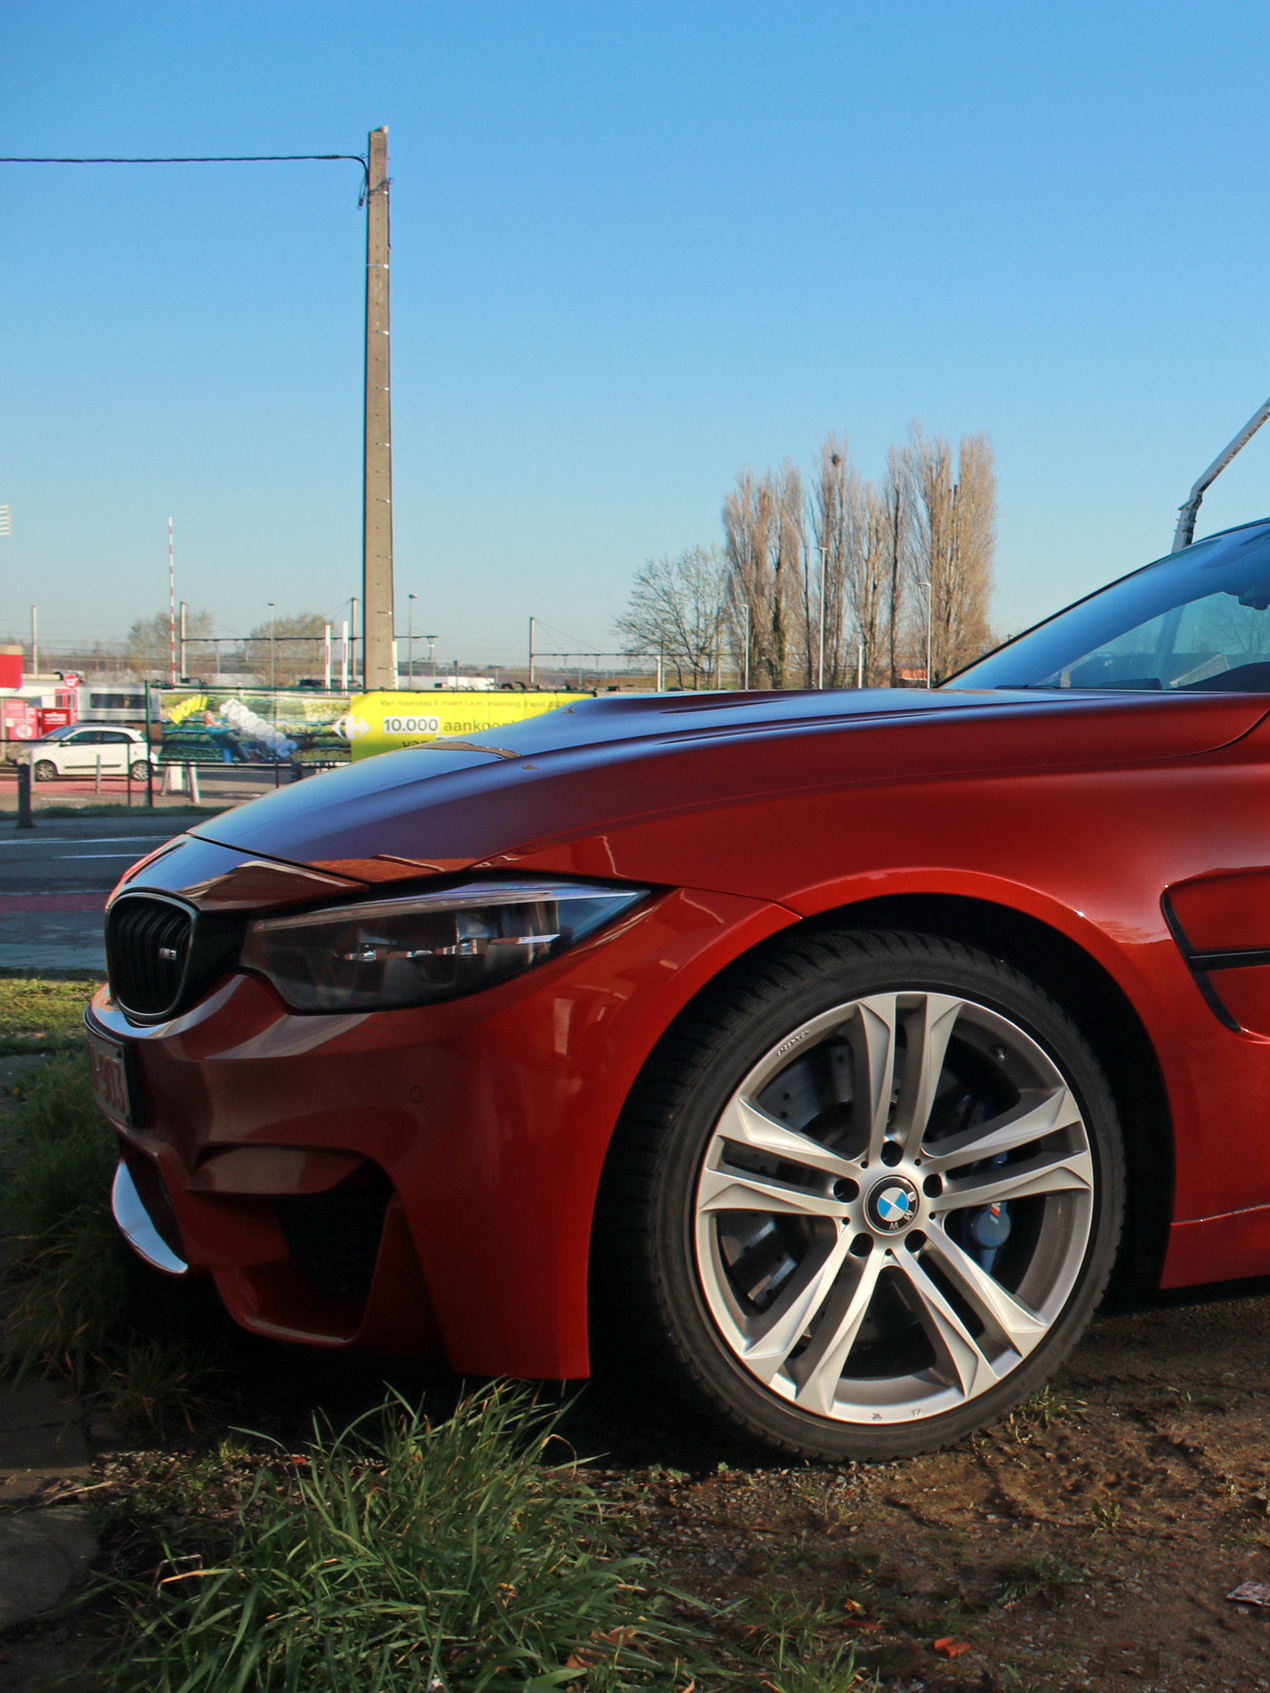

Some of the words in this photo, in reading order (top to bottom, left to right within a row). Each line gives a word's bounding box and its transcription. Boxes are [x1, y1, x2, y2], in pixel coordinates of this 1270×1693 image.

[167, 694, 209, 725] WOW!
[379, 699, 395, 707] Van
[397, 699, 432, 708] maandag
[441, 699, 463, 707] maart
[487, 700, 521, 708] maandag
[530, 700, 545, 709] april
[383, 718, 438, 732] 10.000
